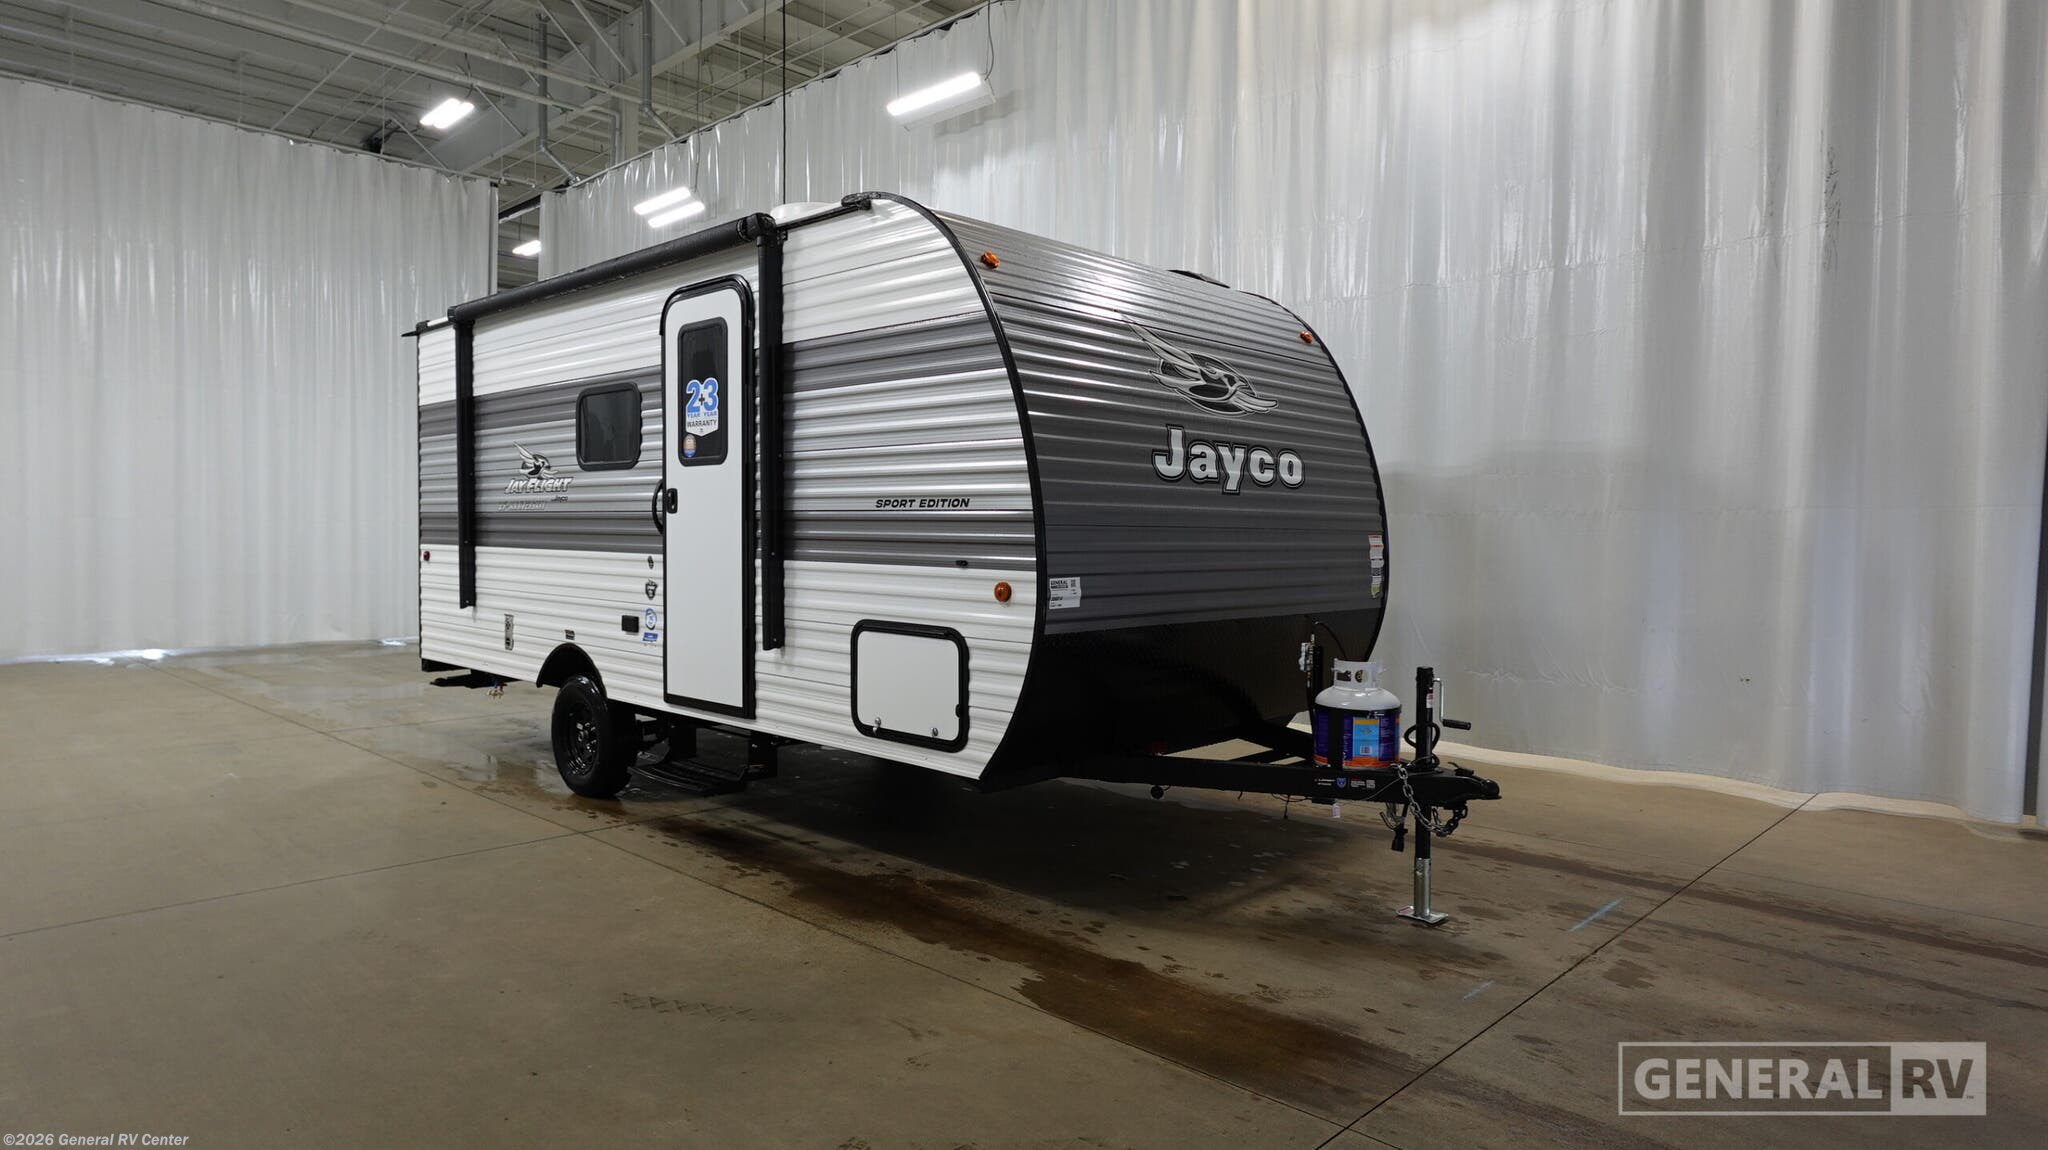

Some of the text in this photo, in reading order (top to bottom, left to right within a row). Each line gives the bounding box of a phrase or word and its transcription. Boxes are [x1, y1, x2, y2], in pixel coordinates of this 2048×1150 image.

[687, 419, 717, 428] WARRANTY
[1152, 424, 1305, 494] Jayco
[875, 498, 970, 508] SPORT EDITION
